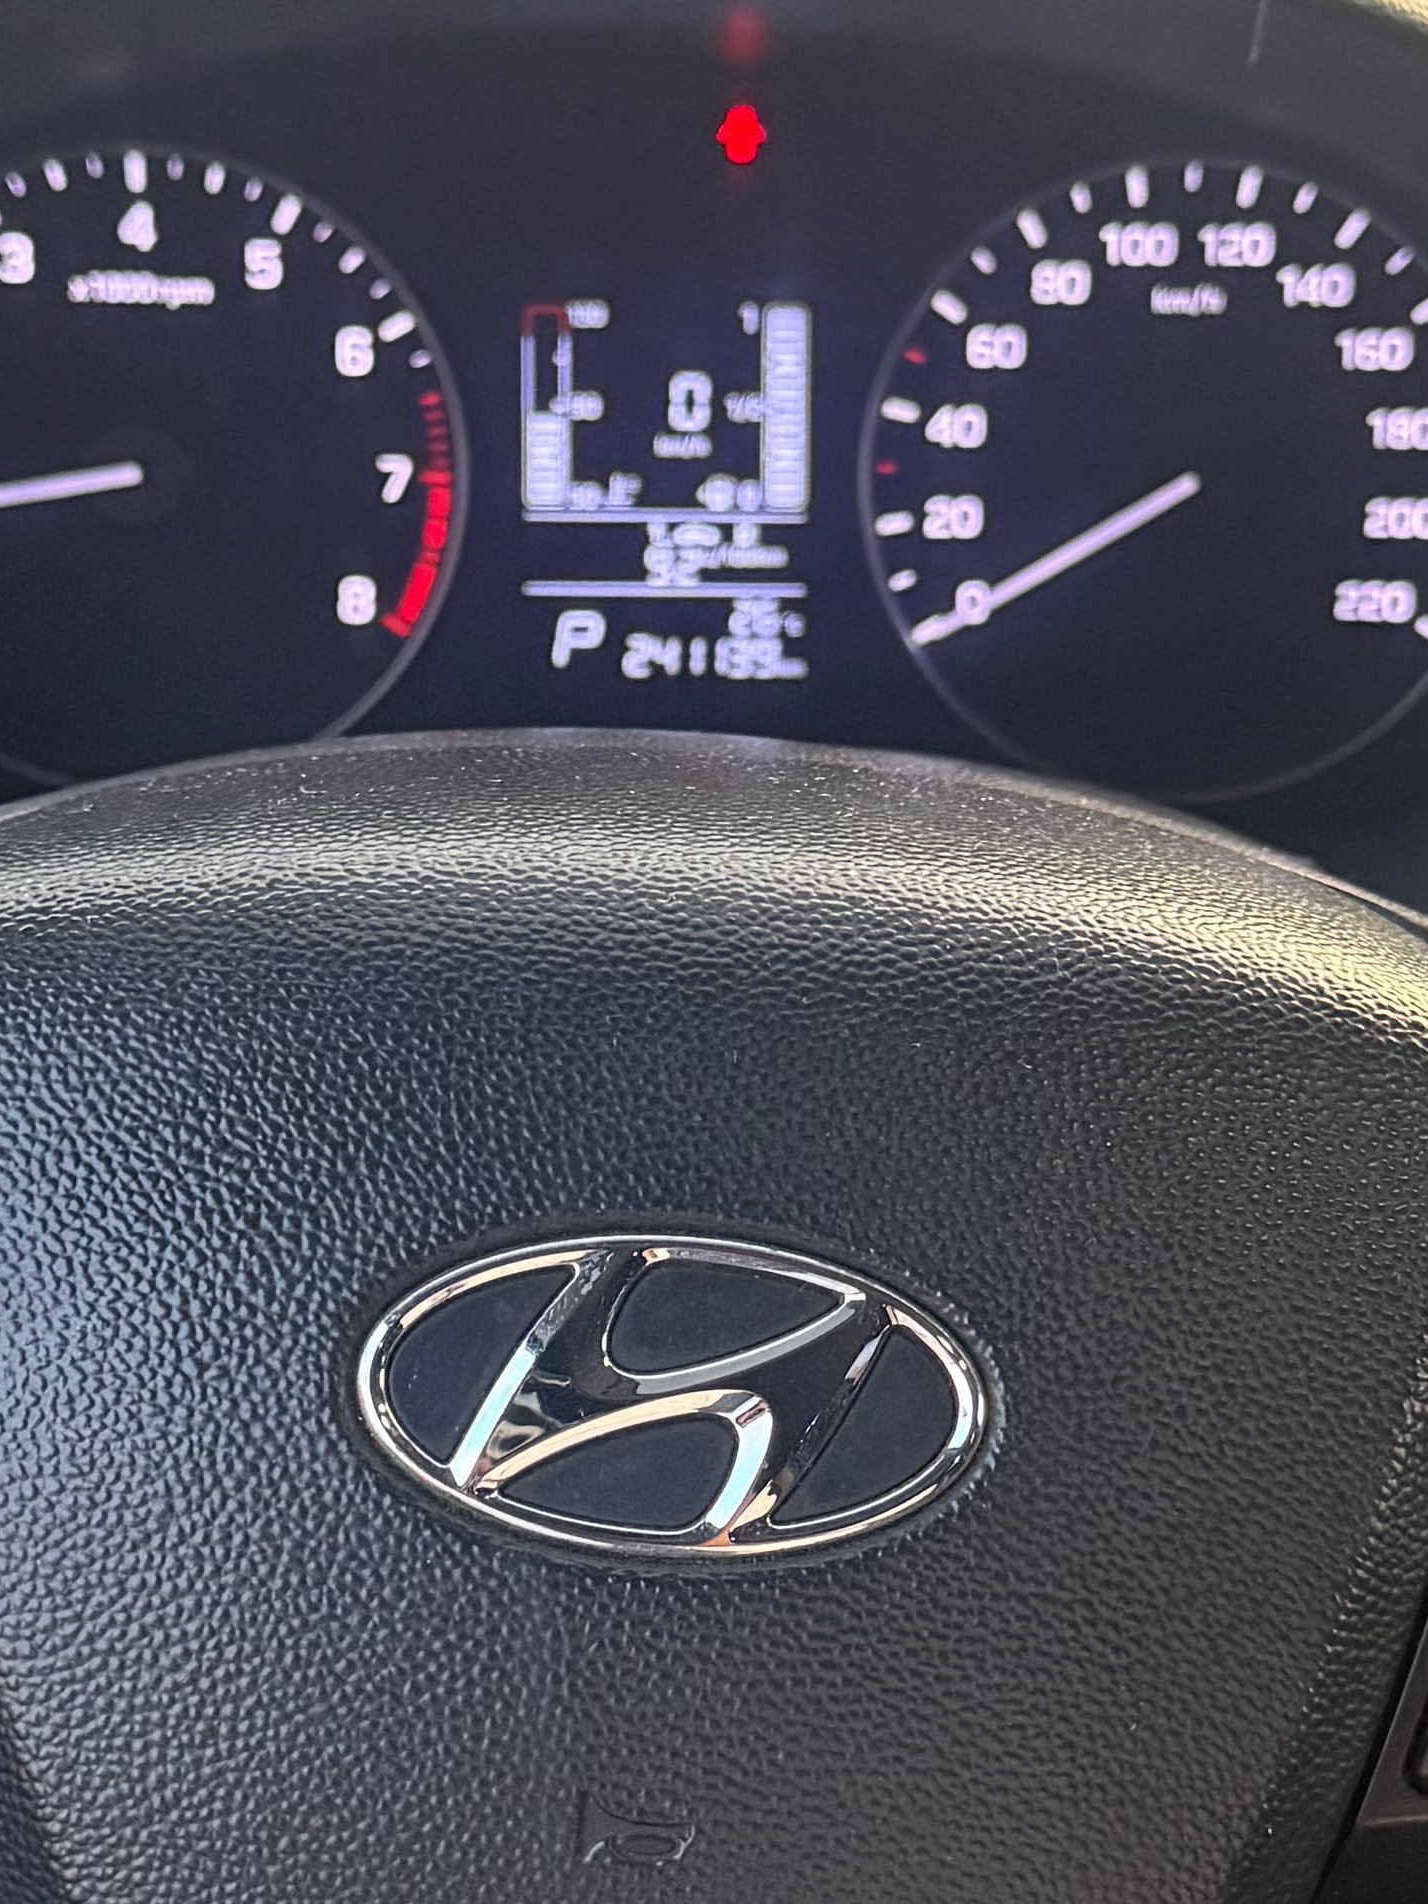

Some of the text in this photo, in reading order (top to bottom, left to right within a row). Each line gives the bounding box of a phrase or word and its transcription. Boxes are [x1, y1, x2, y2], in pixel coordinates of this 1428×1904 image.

[117, 201, 158, 252] 4
[1099, 221, 1179, 267] 100
[1197, 221, 1276, 267] 120
[243, 237, 284, 290] 5
[1030, 258, 1092, 305] 80
[1275, 262, 1356, 309] 140
[334, 325, 375, 377] 6
[966, 323, 1028, 370] 60
[1334, 326, 1414, 371] 160
[668, 369, 713, 432] 0
[924, 403, 988, 449] 40
[375, 454, 412, 503] 7
[923, 494, 984, 539] 20
[336, 574, 376, 625] 8
[954, 579, 993, 625] 0
[1332, 579, 1416, 624] 220
[552, 610, 606, 669] P
